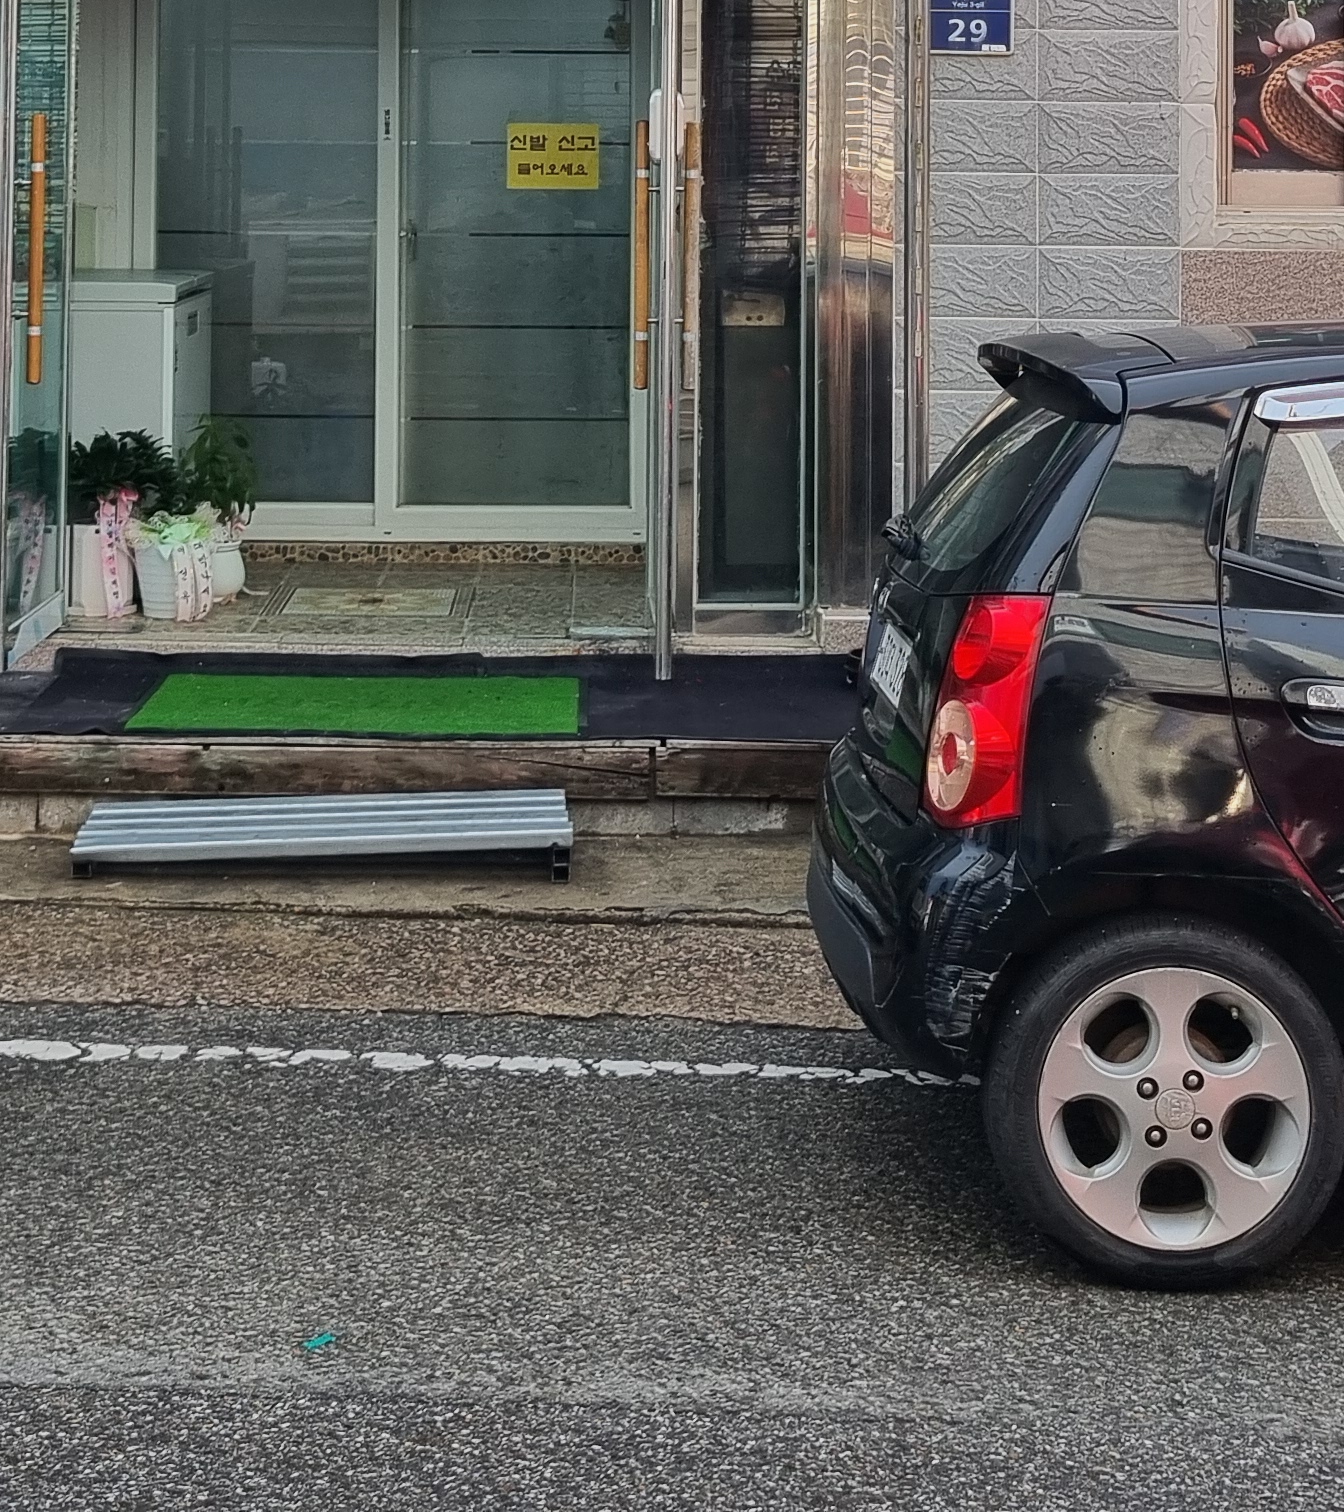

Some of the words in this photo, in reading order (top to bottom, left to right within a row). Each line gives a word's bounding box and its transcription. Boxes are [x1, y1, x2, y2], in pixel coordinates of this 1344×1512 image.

[947, 18, 988, 43] 29
[509, 134, 549, 152] 신발
[558, 134, 597, 152] 신고
[517, 162, 589, 176] 들어오세요
